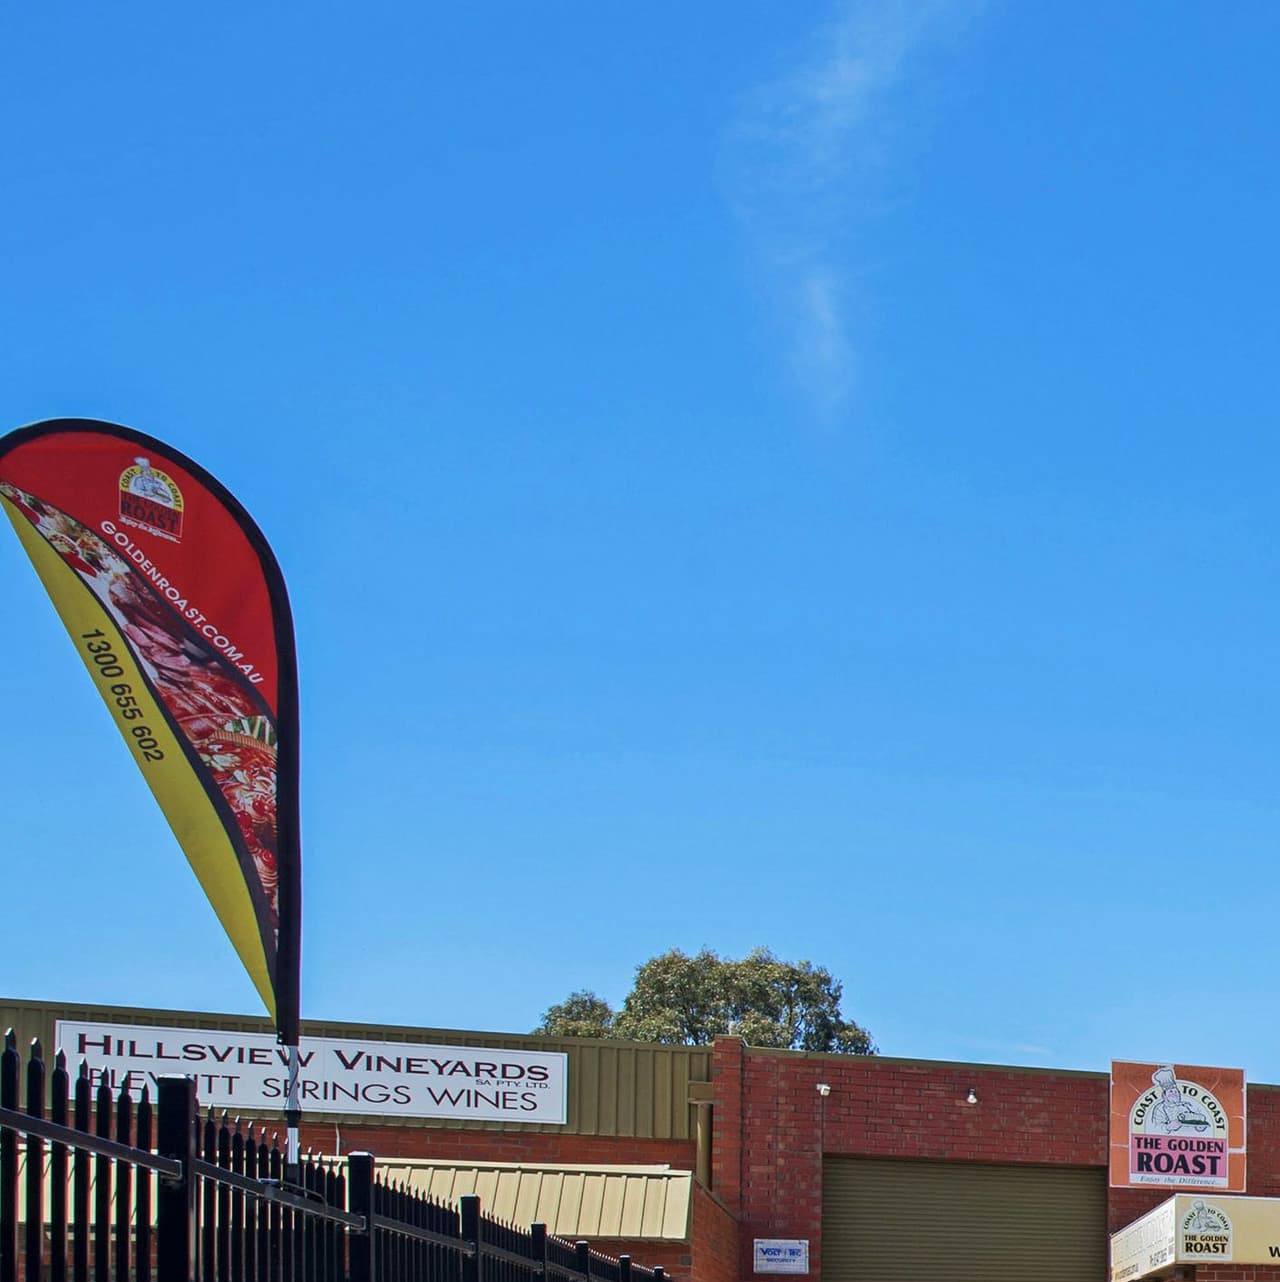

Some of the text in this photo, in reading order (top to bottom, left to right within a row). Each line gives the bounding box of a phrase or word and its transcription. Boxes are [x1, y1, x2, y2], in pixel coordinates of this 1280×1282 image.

[100, 521, 264, 684] GOLDENROAST.COM.AU
[82, 628, 164, 762] 1300 655 602
[78, 1033, 550, 1081] HILLSVIEW VINEYARDS
[475, 1078, 492, 1087] SA
[427, 1087, 538, 1111] WINES
[1134, 1085, 1225, 1130] COAST TO COAST
[1135, 1137, 1224, 1153] THE GOLDEN
[1137, 1152, 1221, 1175] ROAST
[1185, 1242, 1227, 1253] ROAST
